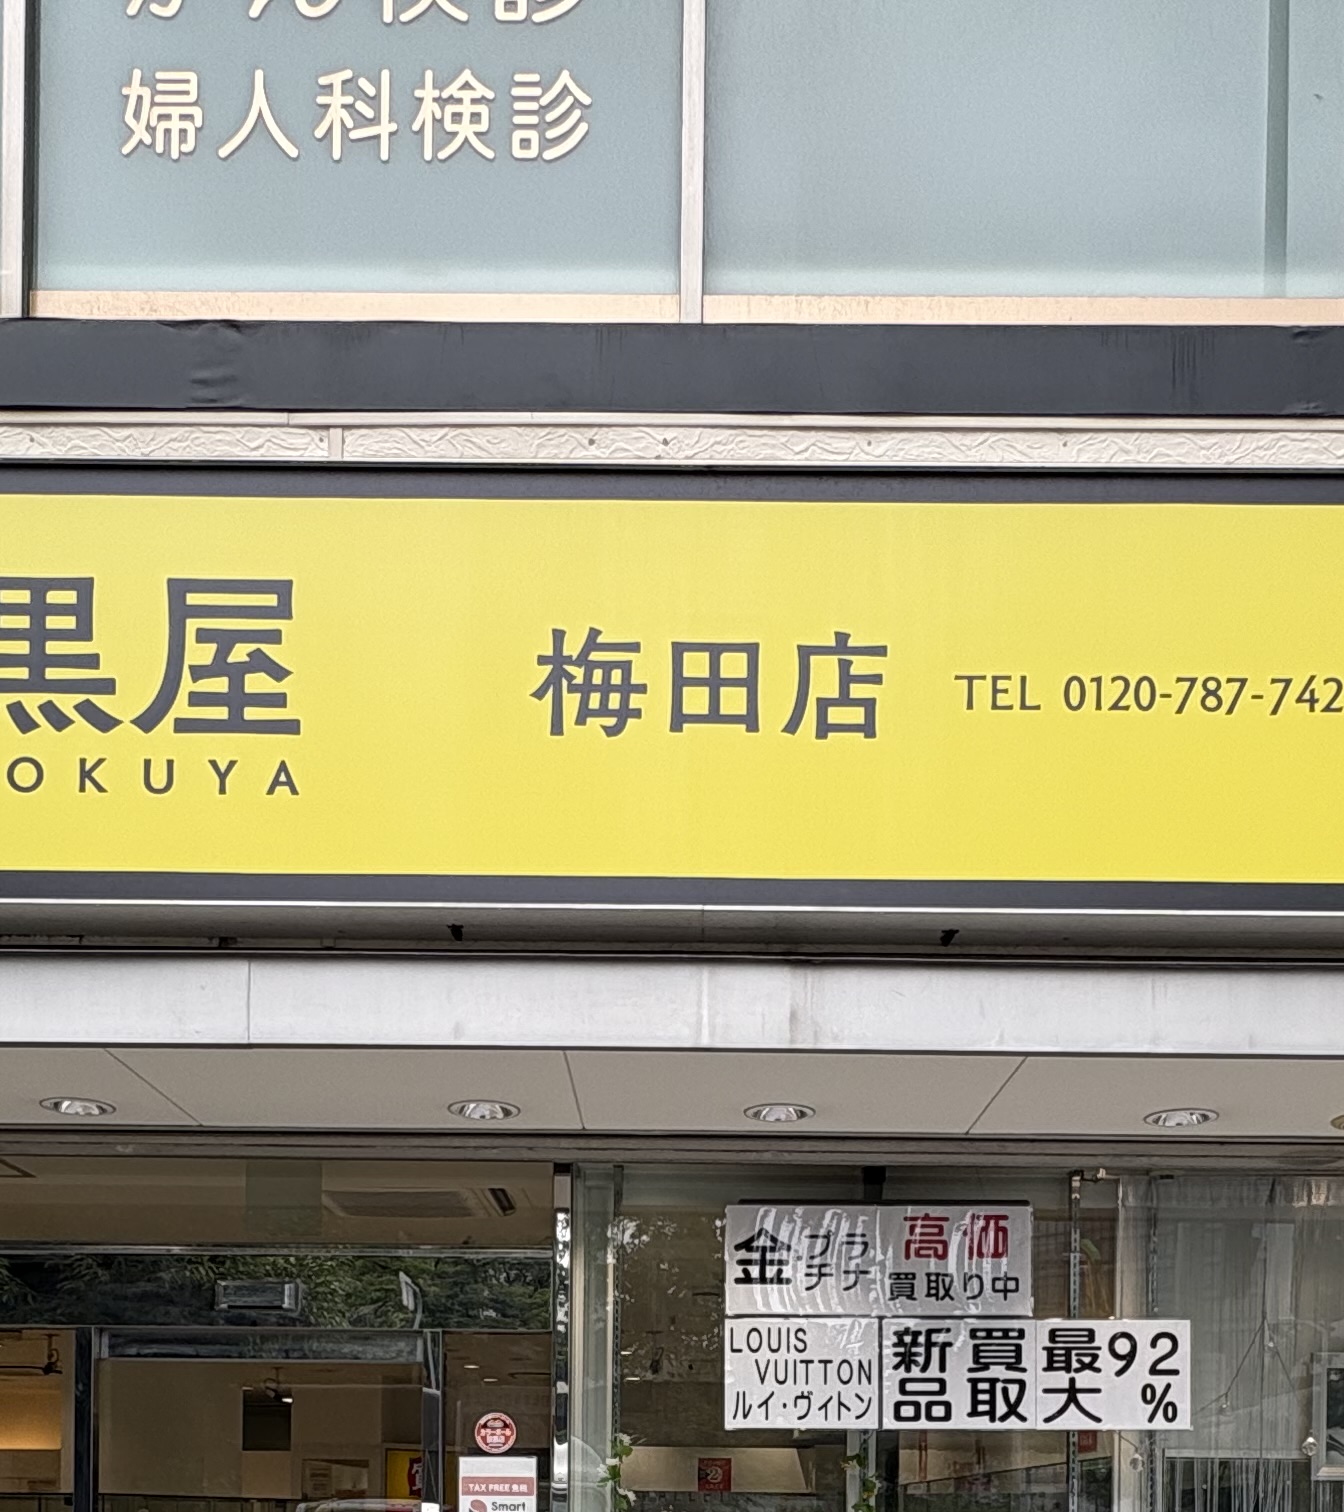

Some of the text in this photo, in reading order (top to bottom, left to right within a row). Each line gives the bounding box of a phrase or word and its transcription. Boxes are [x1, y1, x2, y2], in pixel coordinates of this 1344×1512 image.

[121, 68, 593, 162] 婦人科検診
[531, 626, 889, 740] 梅田店
[954, 674, 1344, 717] TEL 0120-787-742
[903, 1213, 1010, 1261] 高価
[888, 1271, 1020, 1301] 買取り中
[730, 1327, 808, 1353] LOUIS
[755, 1358, 873, 1386] VUITTON
[732, 1390, 873, 1422] ルイ・ヴィトン
[491, 1501, 526, 1512] Smart
